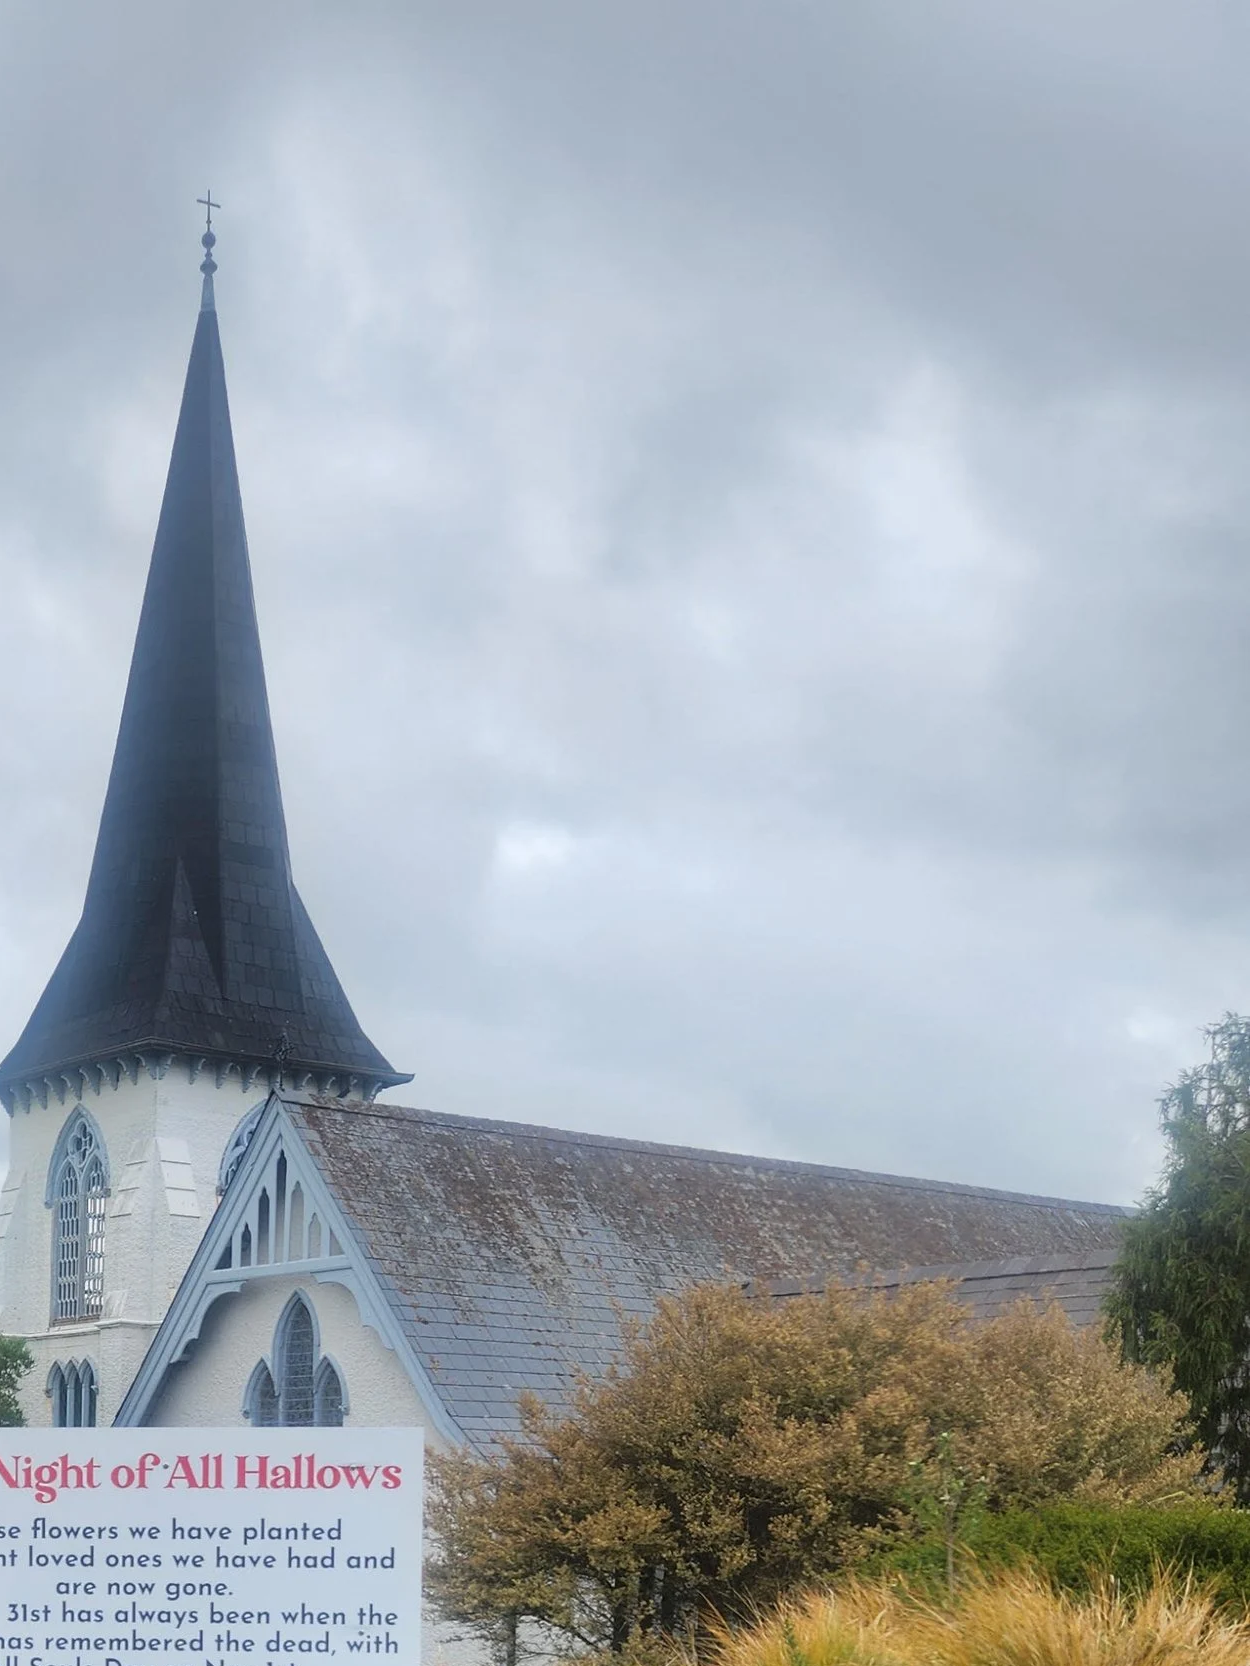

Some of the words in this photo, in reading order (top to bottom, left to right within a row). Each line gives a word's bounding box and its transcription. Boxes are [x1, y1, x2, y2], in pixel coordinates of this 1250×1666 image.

[111, 1453, 160, 1488] of
[165, 1454, 223, 1488] All
[235, 1454, 401, 1489] Hallows
[31, 1518, 118, 1539] flowers
[129, 1527, 160, 1539] we
[172, 1518, 232, 1539] have
[244, 1518, 341, 1545] planted
[29, 1545, 94, 1567] loved
[106, 1555, 161, 1567] ones
[173, 1555, 204, 1567] we
[216, 1546, 276, 1568] have
[288, 1547, 334, 1568] had
[347, 1547, 394, 1569] and
[56, 1582, 96, 1596] are
[108, 1583, 154, 1596] now
[165, 1583, 233, 1601] gone.
[8, 1604, 51, 1622] 31st
[62, 1601, 103, 1622] has
[115, 1601, 198, 1628] always
[210, 1602, 269, 1624] been
[282, 1603, 345, 1624] when
[358, 1604, 398, 1625] the
[46, 1629, 203, 1651] remembered
[215, 1630, 255, 1652] the
[266, 1631, 335, 1656] dead,
[347, 1631, 398, 1653] with
